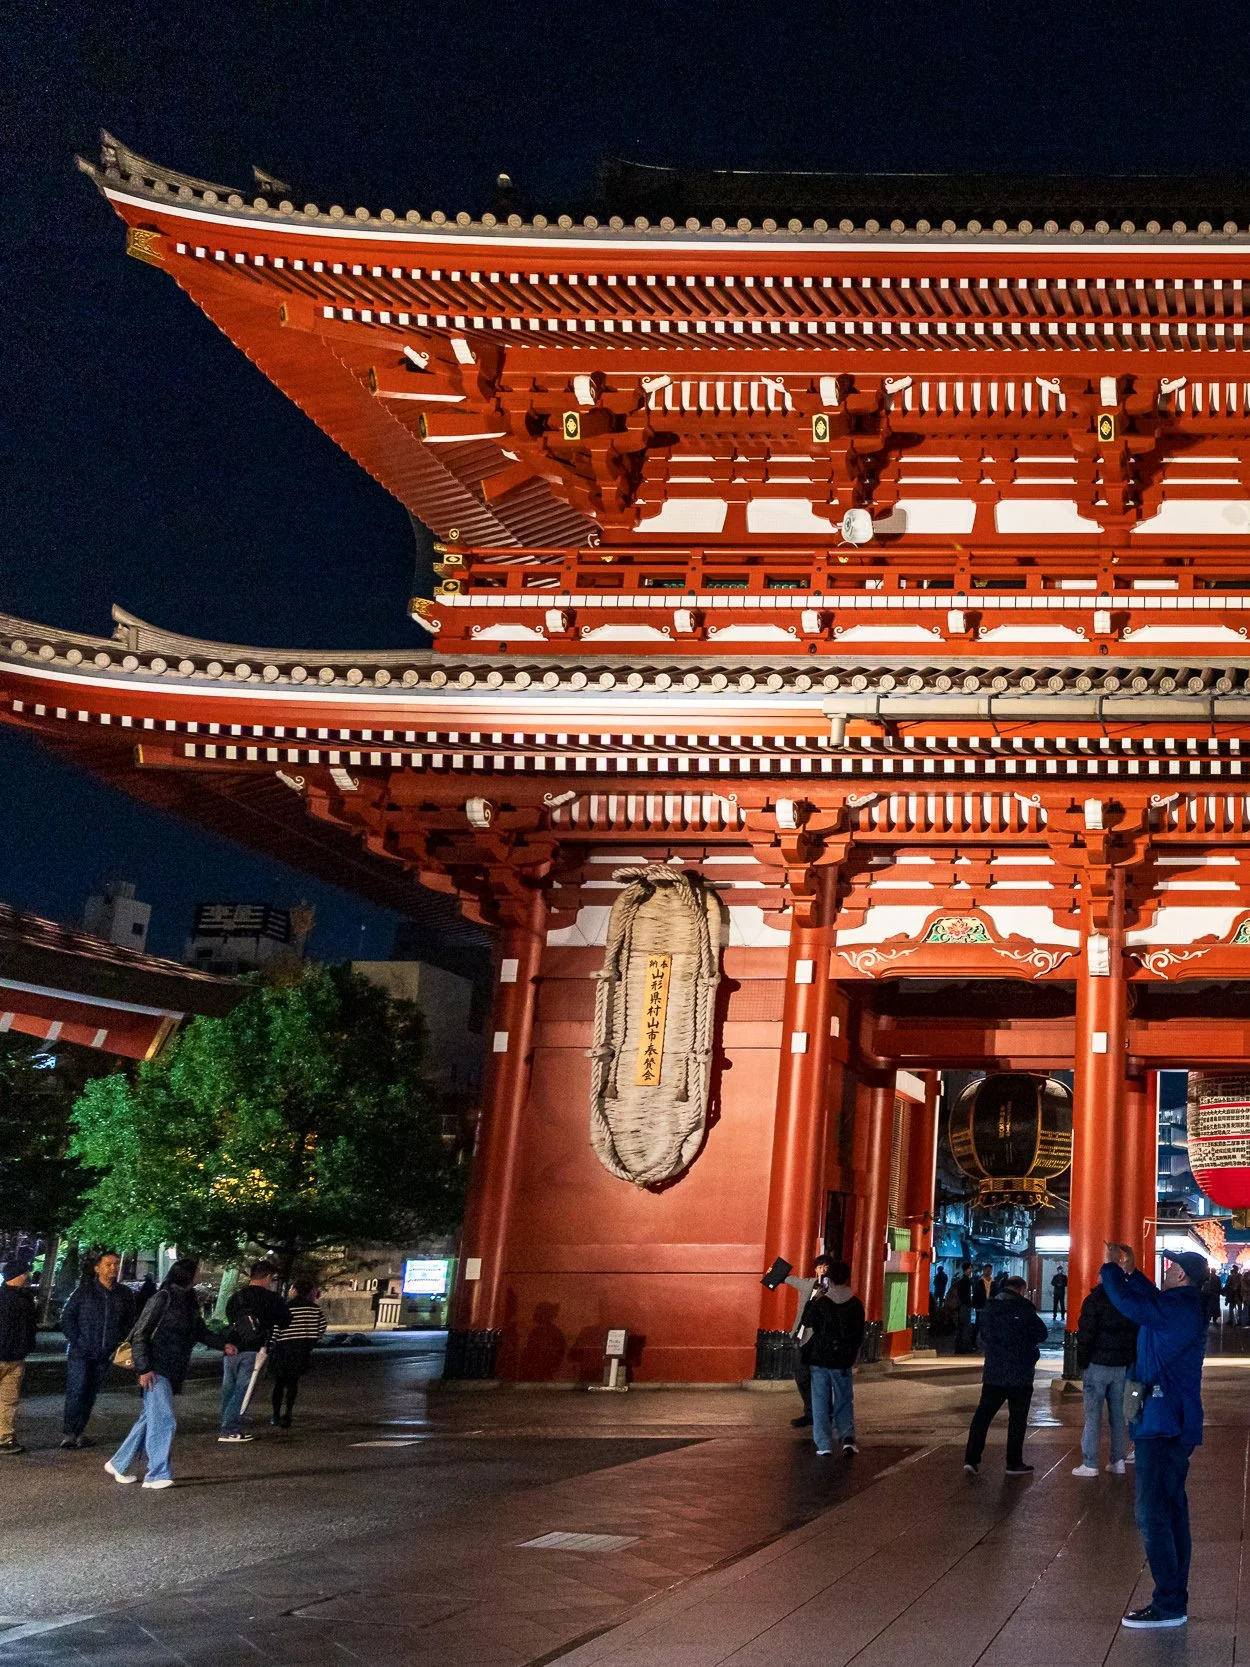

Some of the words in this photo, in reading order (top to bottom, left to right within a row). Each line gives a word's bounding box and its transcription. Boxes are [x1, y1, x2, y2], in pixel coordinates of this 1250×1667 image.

[642, 968, 664, 1081] 山形県村山市奉賛会
